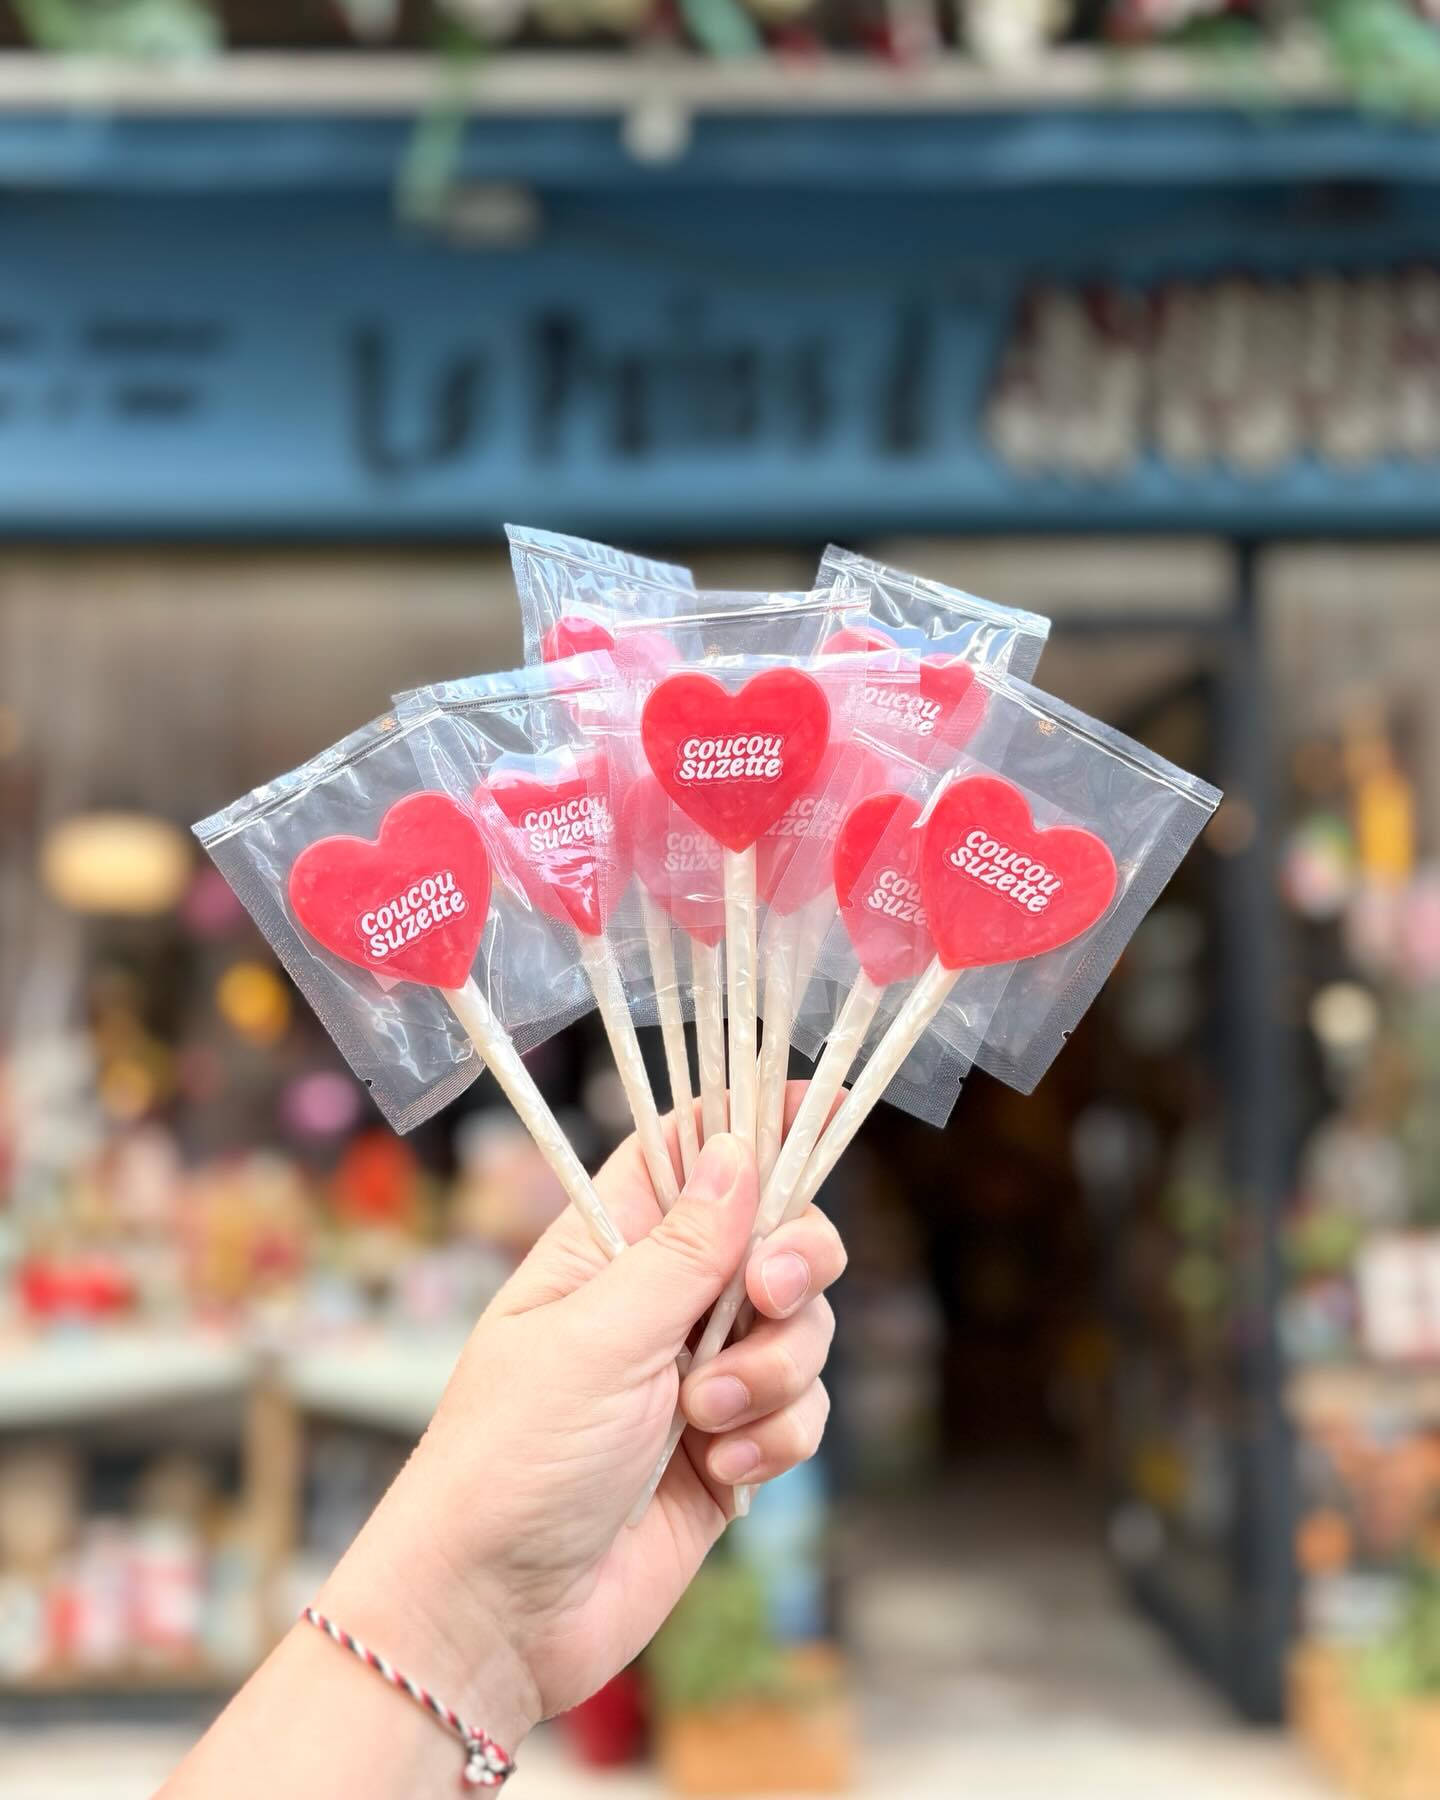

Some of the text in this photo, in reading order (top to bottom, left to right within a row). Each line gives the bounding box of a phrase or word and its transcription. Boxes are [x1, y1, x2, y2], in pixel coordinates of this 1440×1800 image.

[683, 735, 782, 759] coucou
[679, 754, 781, 780] suzette
[525, 796, 607, 833] coucou
[666, 831, 721, 853] cou
[664, 852, 721, 872] suze
[950, 846, 1048, 912] suzette
[965, 830, 1061, 896] coucou
[361, 872, 456, 935] coucou
[879, 870, 922, 904] cou
[369, 891, 466, 957] suzette
[867, 888, 928, 926] suze
